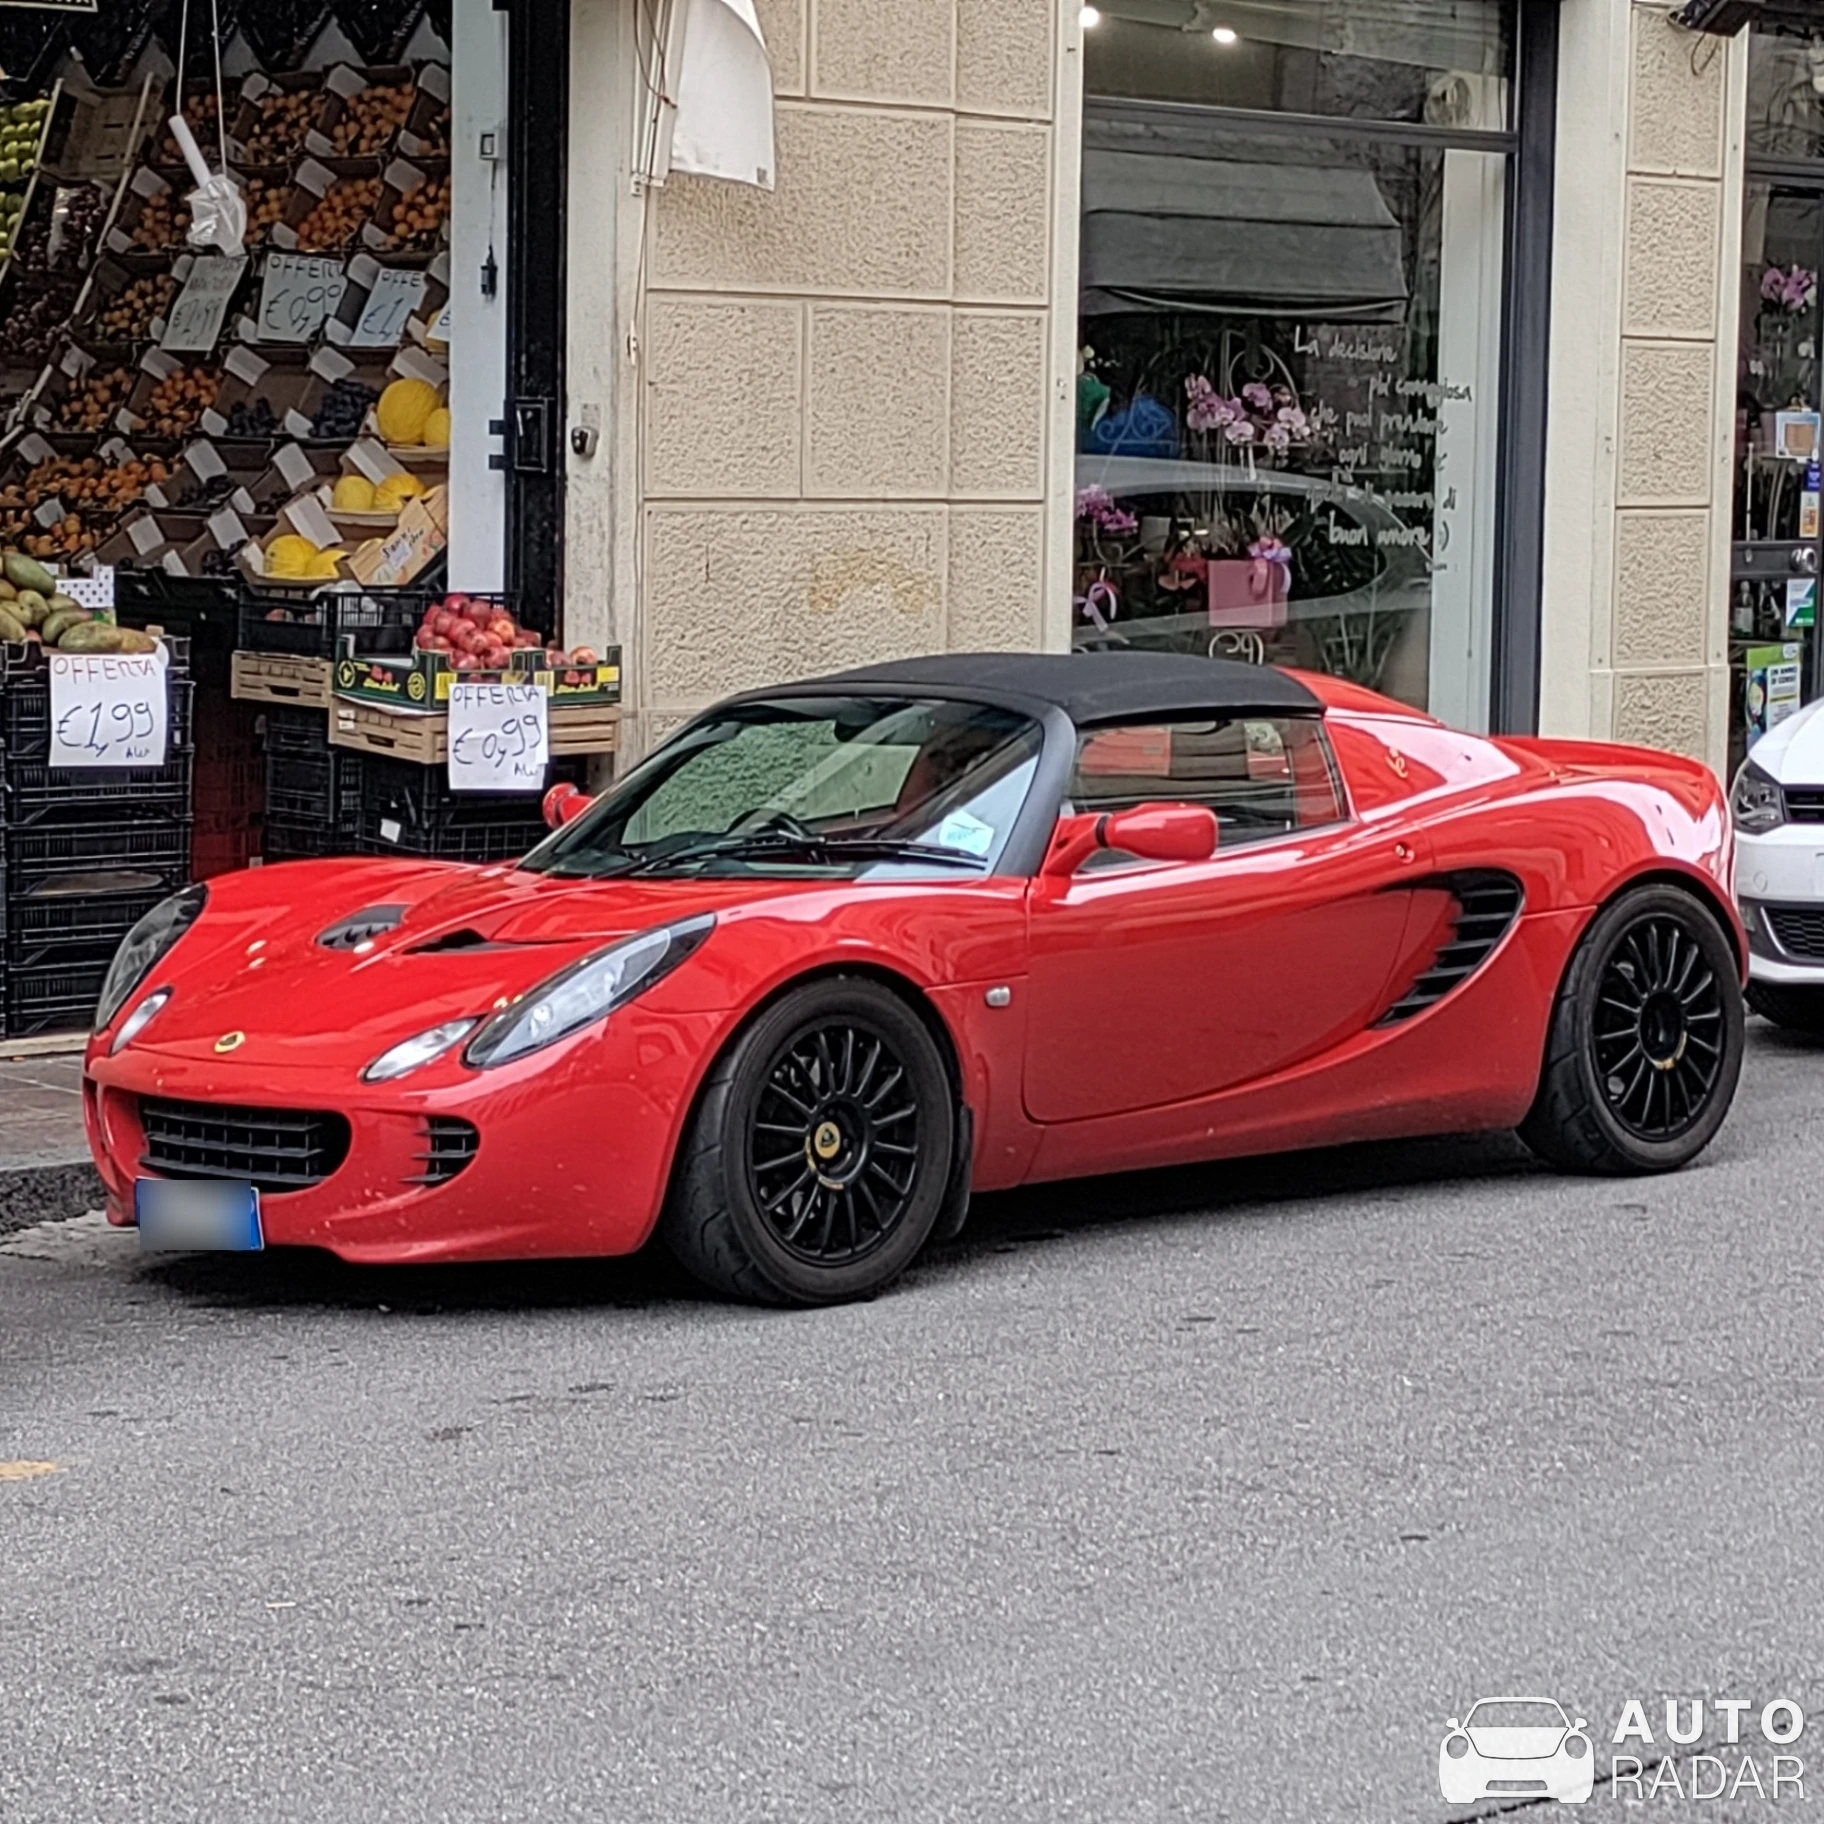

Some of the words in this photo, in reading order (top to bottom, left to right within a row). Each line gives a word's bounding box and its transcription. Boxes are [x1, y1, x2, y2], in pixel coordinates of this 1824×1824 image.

[1329, 509, 1369, 547] buon
[53, 656, 157, 685] OFFERTA
[452, 685, 541, 710] OFFERTA
